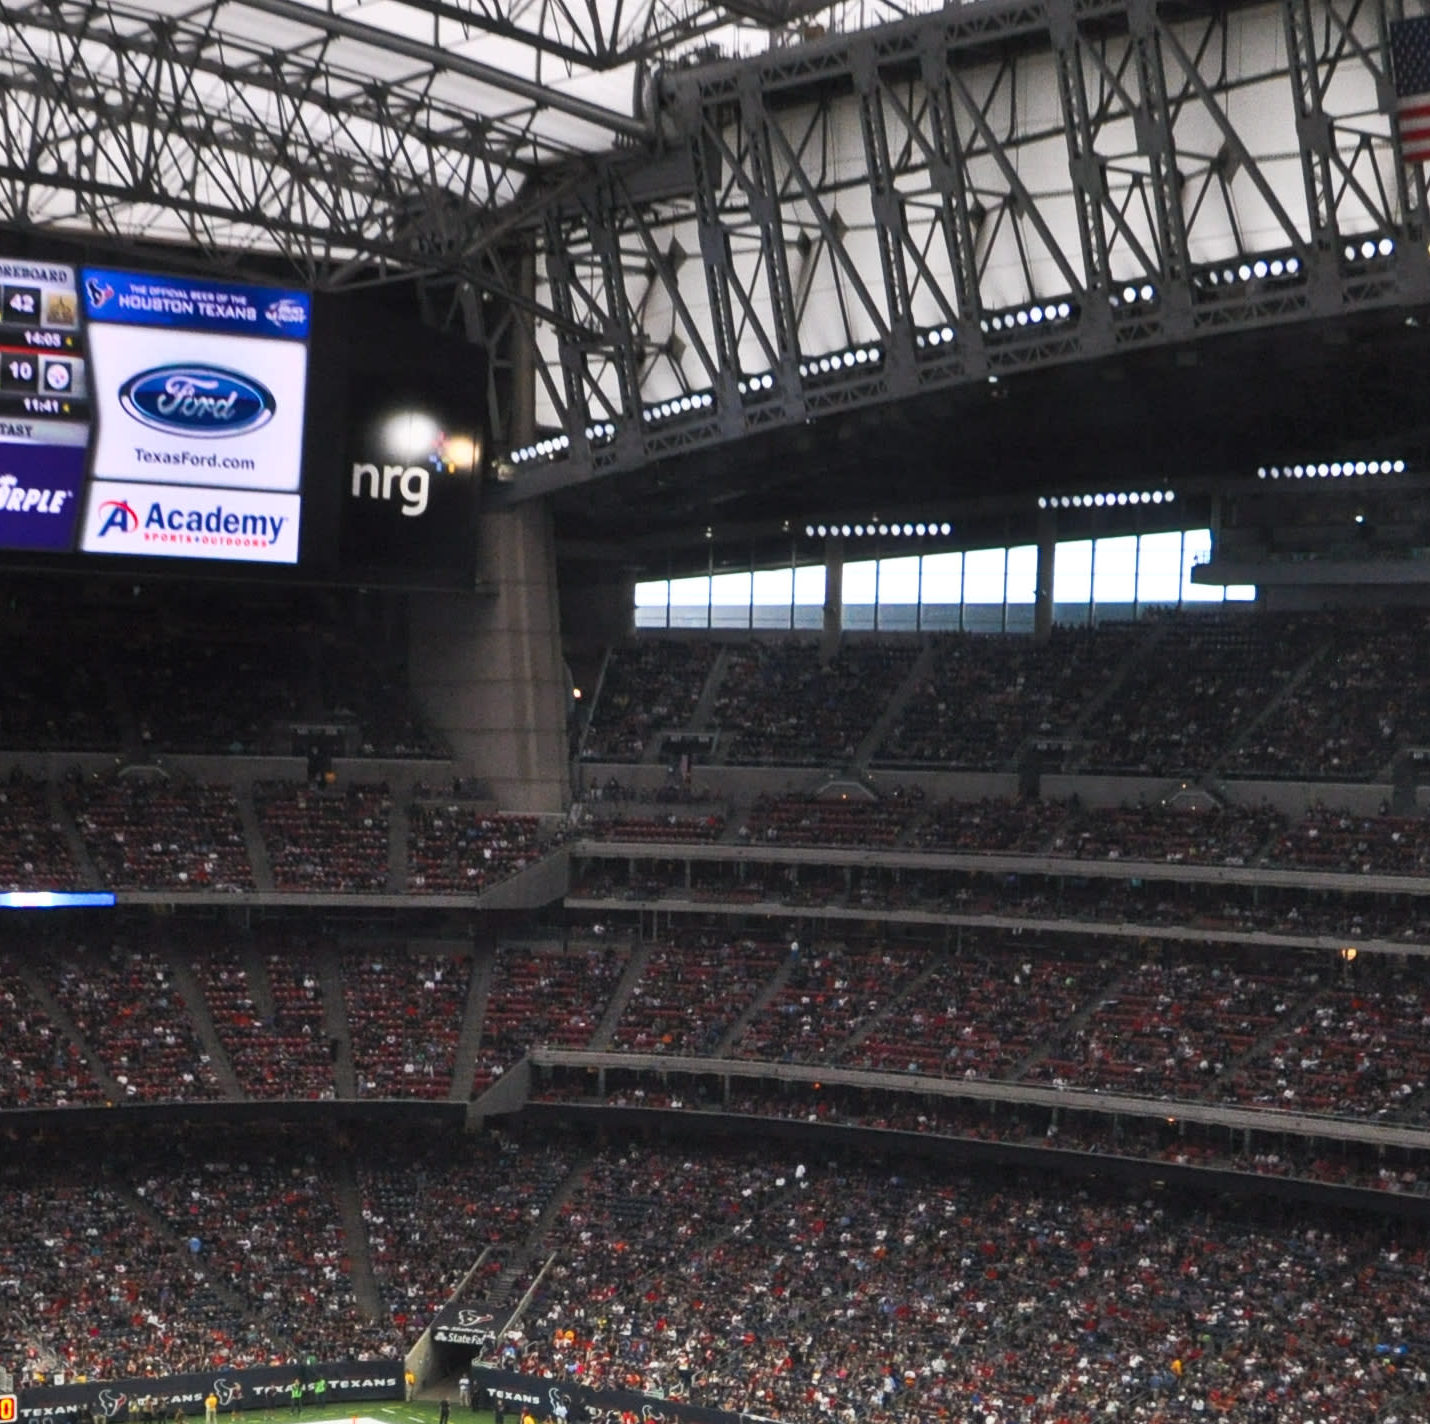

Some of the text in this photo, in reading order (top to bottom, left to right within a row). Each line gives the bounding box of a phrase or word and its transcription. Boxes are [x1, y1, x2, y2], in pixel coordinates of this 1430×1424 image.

[9, 293, 35, 313] 42
[119, 293, 258, 322] HOUSTON TEXANS
[9, 360, 32, 381] 10
[158, 375, 239, 420] Ford
[134, 448, 256, 471] TexasFord.com
[352, 461, 429, 517] nrg
[144, 501, 286, 546] Academy
[328, 1377, 397, 1389] TEXANS
[486, 1387, 540, 1405] TEXANS
